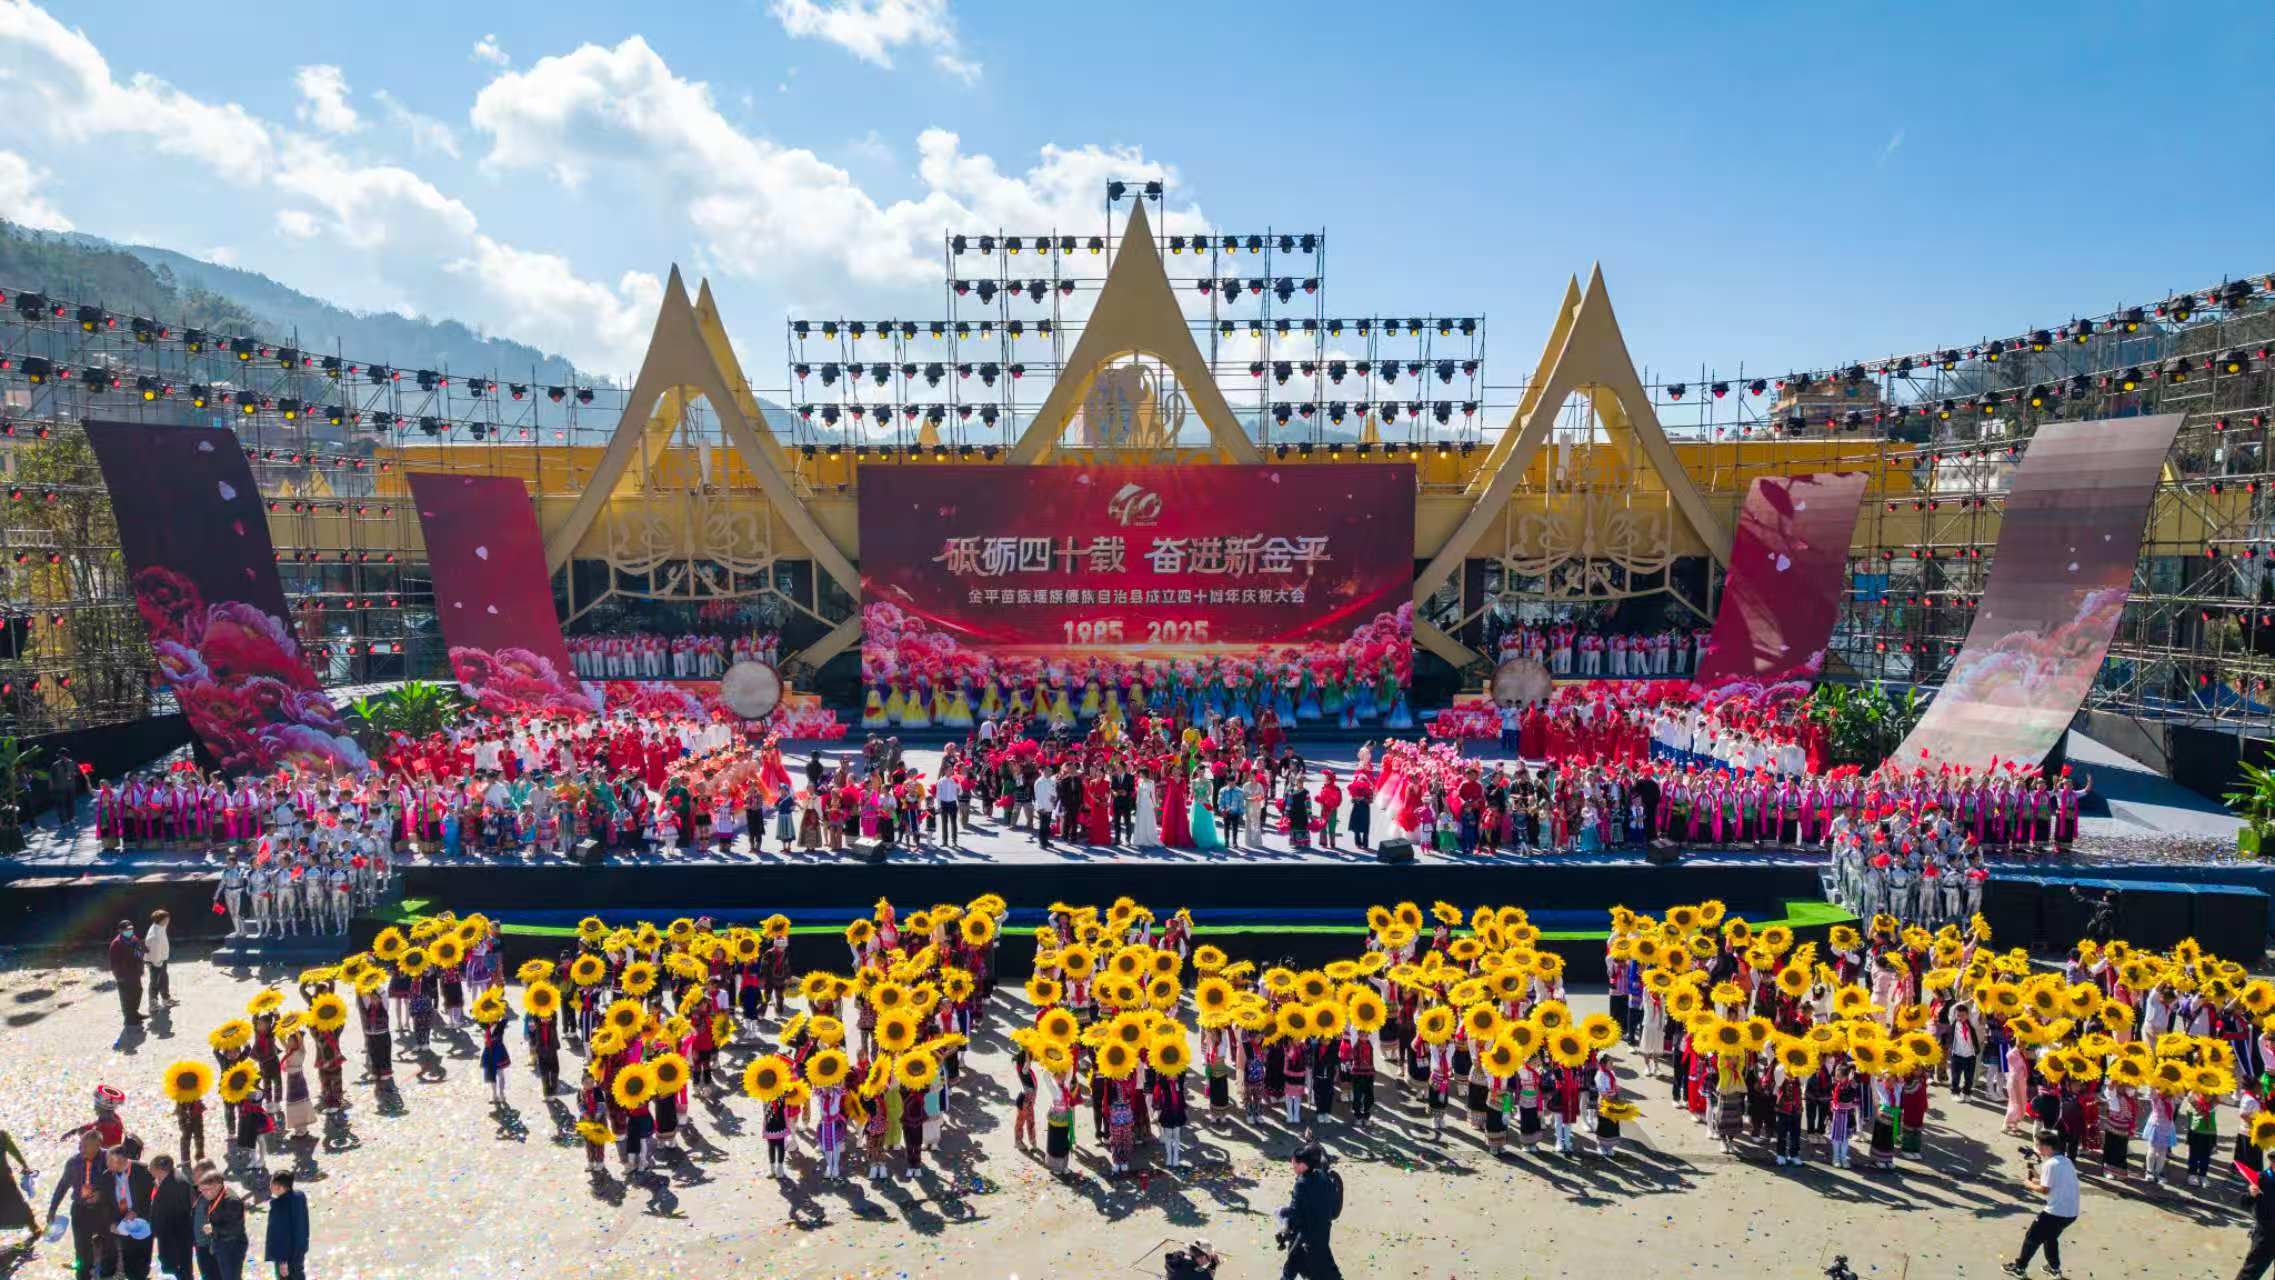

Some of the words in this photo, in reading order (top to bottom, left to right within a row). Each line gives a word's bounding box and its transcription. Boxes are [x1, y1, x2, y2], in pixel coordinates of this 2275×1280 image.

[932, 536, 1126, 577] 砥砺四十载
[1144, 534, 1333, 578] 奋进新金平
[1064, 620, 1124, 644] 1985
[1147, 620, 1209, 644] 2025
